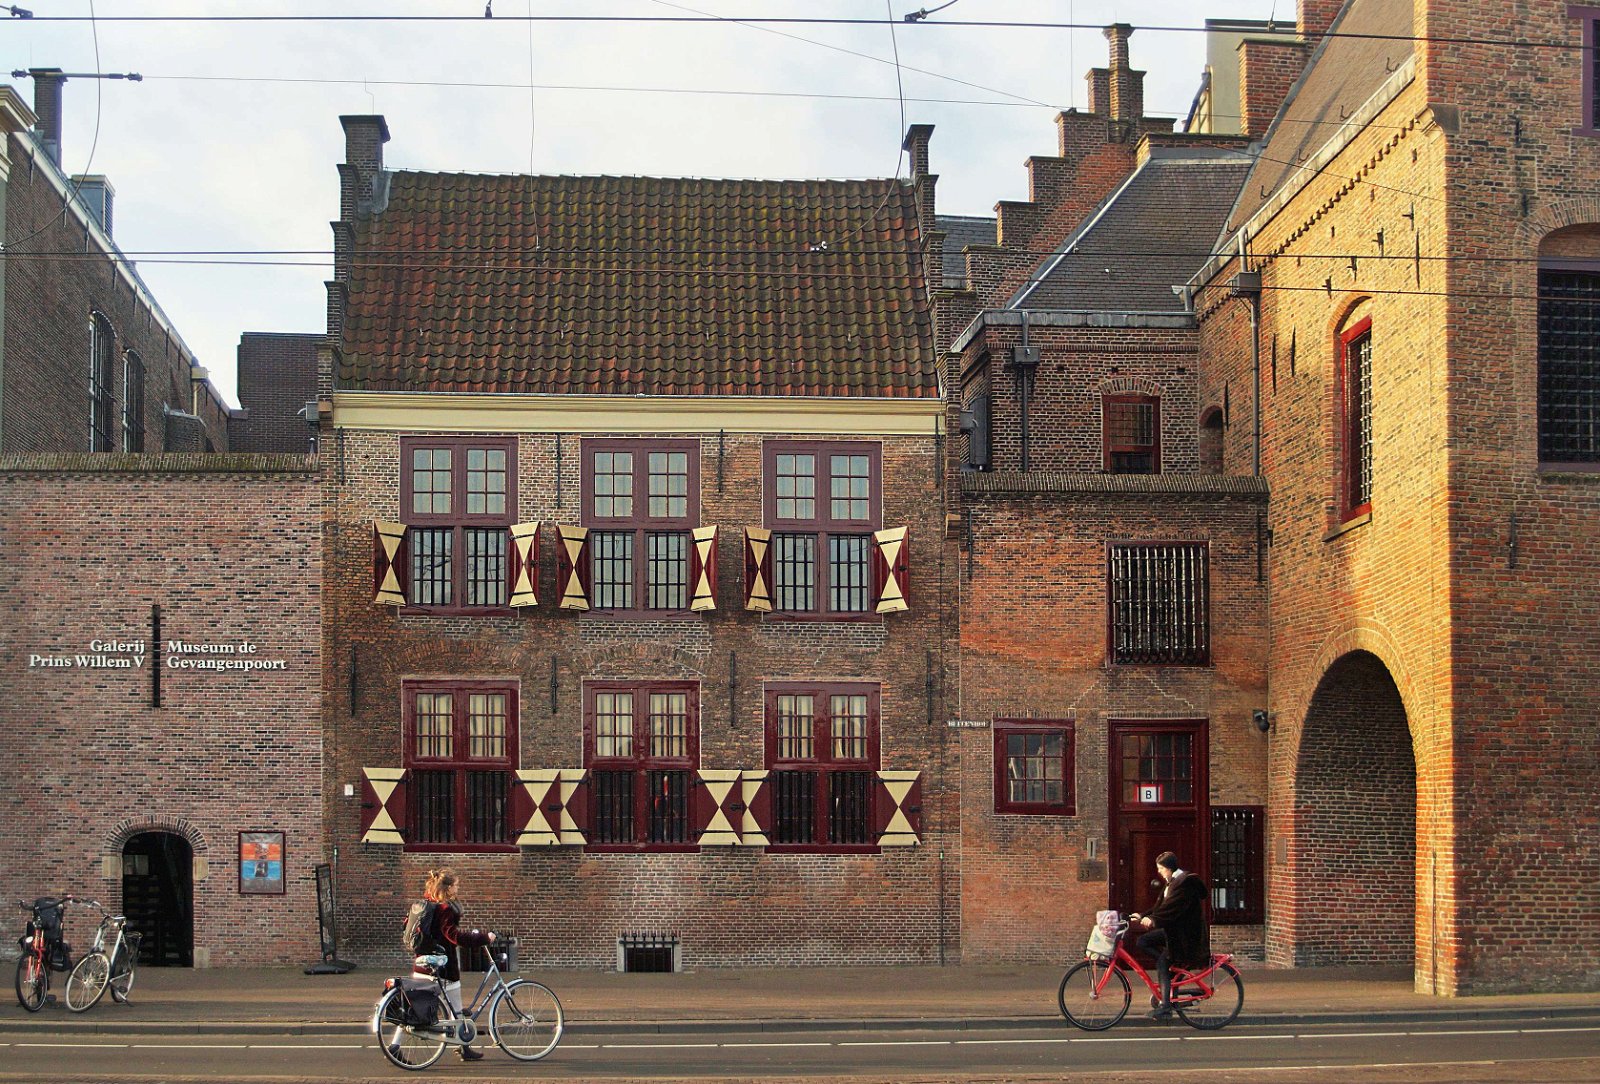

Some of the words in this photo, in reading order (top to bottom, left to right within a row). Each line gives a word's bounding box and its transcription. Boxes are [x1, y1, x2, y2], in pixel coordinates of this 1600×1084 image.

[90, 639, 145, 654] Galerij
[166, 640, 235, 653] Museum
[238, 640, 257, 653] de
[29, 654, 72, 667] Prins
[75, 654, 131, 668] Willem
[133, 655, 145, 668] V
[166, 655, 287, 672] Gevangenpoort
[1145, 790, 1152, 799] B
